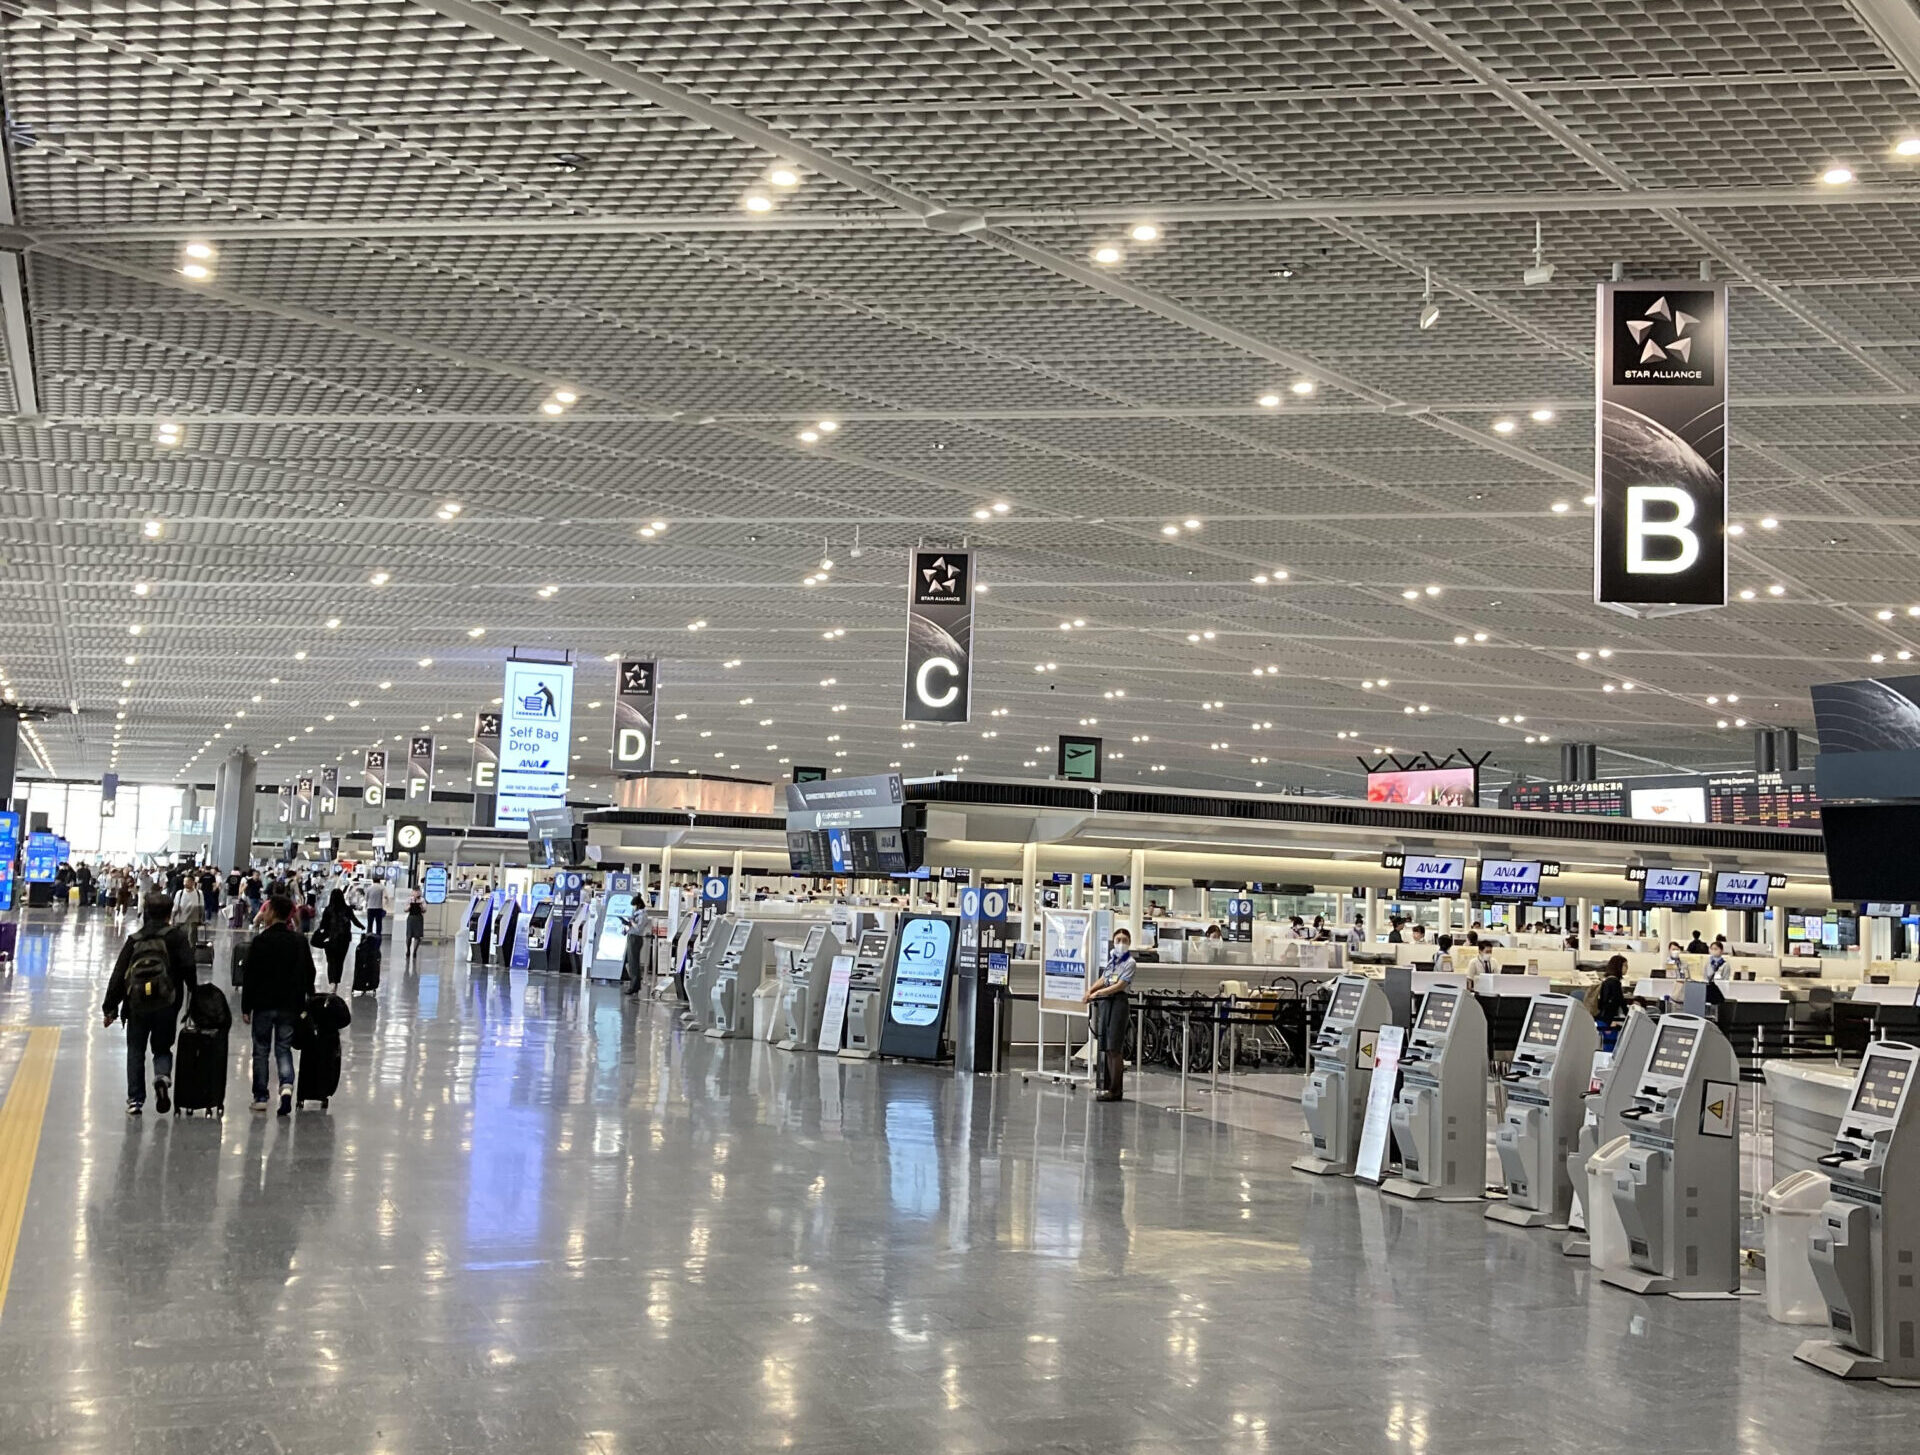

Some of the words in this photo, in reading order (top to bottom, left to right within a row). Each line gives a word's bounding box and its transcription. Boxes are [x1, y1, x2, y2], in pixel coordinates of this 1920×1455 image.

[1625, 370, 1650, 379] STAR
[1653, 370, 1702, 379] ALLIANCE
[1626, 486, 1699, 574] B
[916, 657, 959, 708] C
[509, 726, 533, 738] Self
[536, 728, 559, 742] Bag
[509, 740, 540, 753] Drop
[618, 728, 646, 761] D
[518, 759, 540, 768] ANA
[476, 762, 496, 787] E
[365, 785, 382, 805] G
[410, 778, 426, 799] F
[101, 800, 114, 816] K
[300, 804, 307, 819] I
[320, 796, 335, 813] H
[279, 808, 289, 822] J
[1385, 856, 1403, 867] B14
[1416, 863, 1440, 874] ANA
[1493, 866, 1518, 878] ANA
[1542, 864, 1559, 875] B15
[1629, 869, 1646, 880] B16
[1656, 875, 1679, 885] ANA
[1726, 879, 1749, 889] ANA
[1771, 877, 1786, 887] B17
[711, 882, 718, 895] 1
[967, 895, 973, 912] 1
[988, 895, 996, 913] 1
[1242, 902, 1248, 912] 2
[923, 941, 936, 959] D
